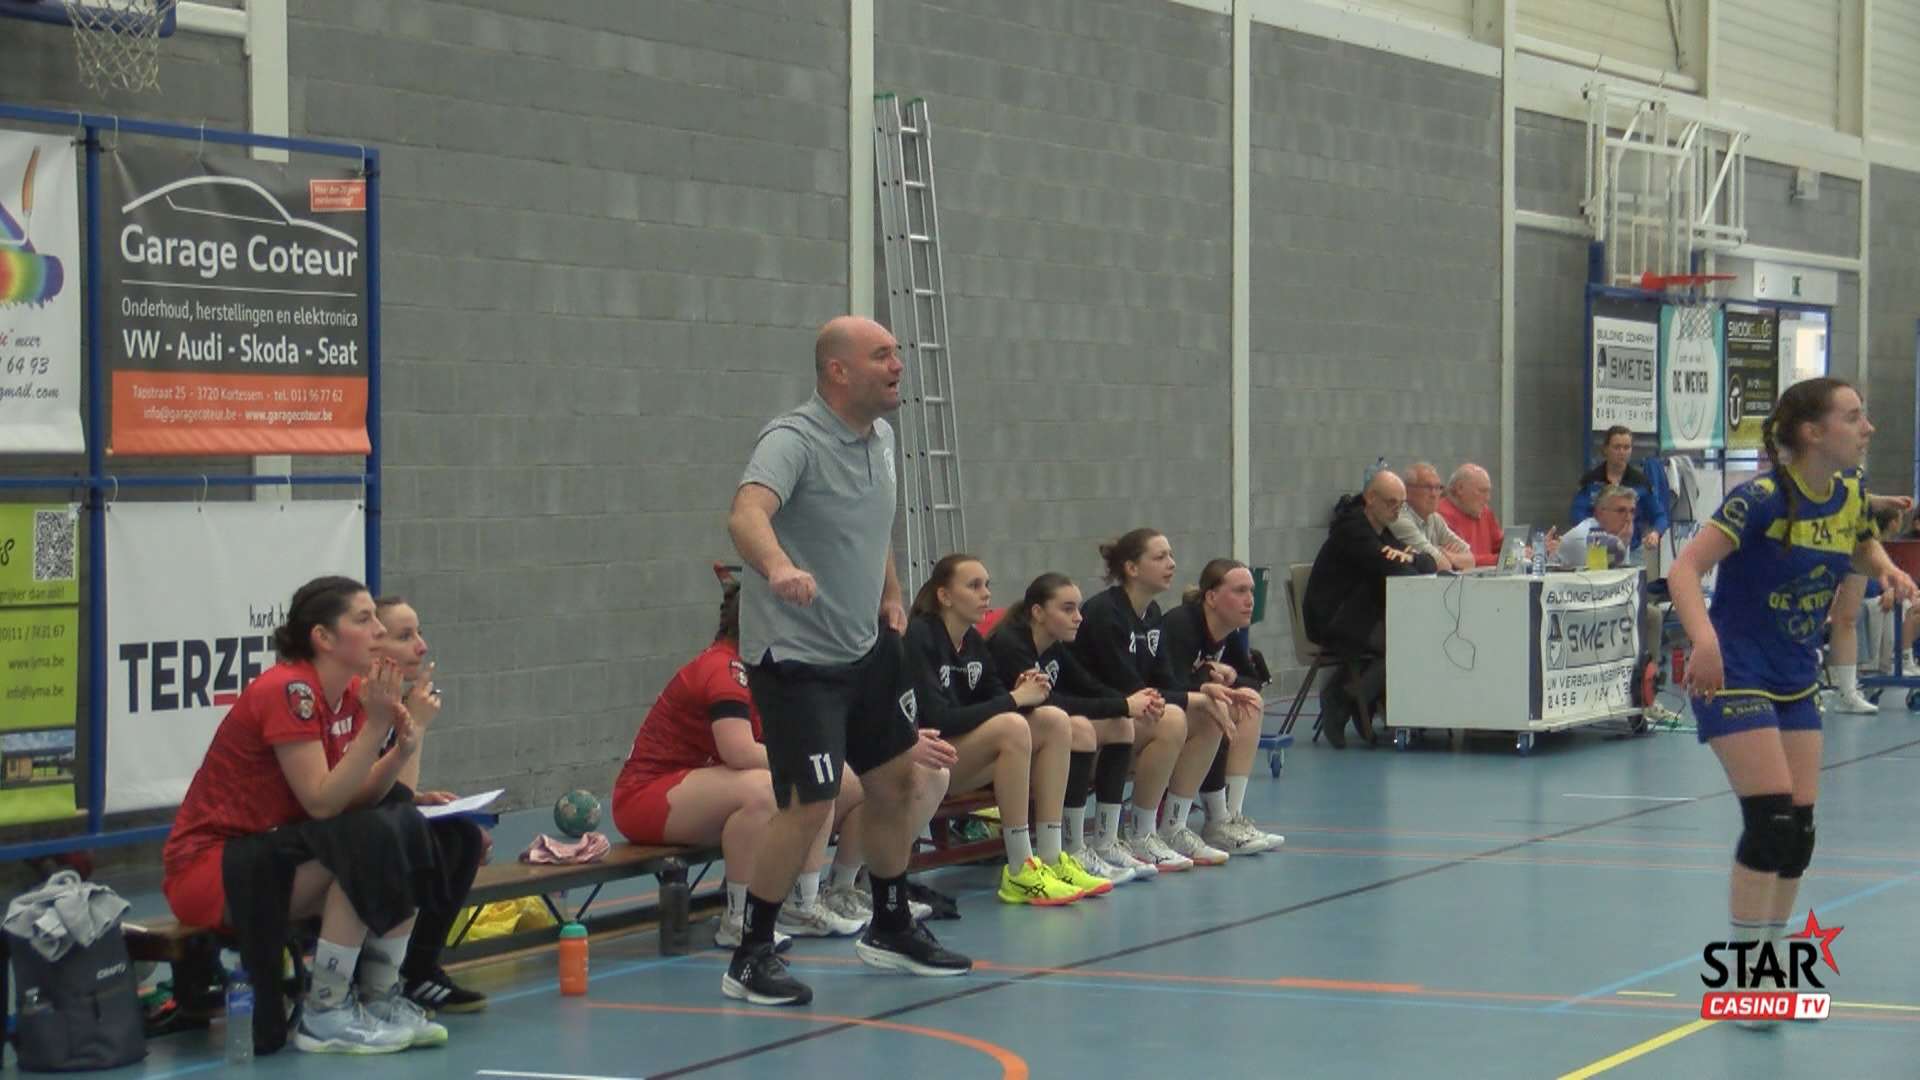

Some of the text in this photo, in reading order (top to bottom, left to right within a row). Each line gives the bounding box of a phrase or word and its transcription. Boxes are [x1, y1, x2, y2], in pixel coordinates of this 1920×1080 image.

[120, 224, 358, 278] Garage Coteur
[121, 296, 358, 328] Onderhoud, herstellingen en elektronica
[122, 329, 161, 359] VW
[177, 331, 223, 361] Audi
[240, 333, 299, 364] Skoda
[318, 337, 358, 366] Seat
[1610, 356, 1653, 381] SMETS
[1672, 370, 1682, 394] DE
[1811, 521, 1832, 544] 24
[249, 603, 276, 628] hard
[1566, 616, 1633, 653] SMETS
[809, 752, 834, 784] T1
